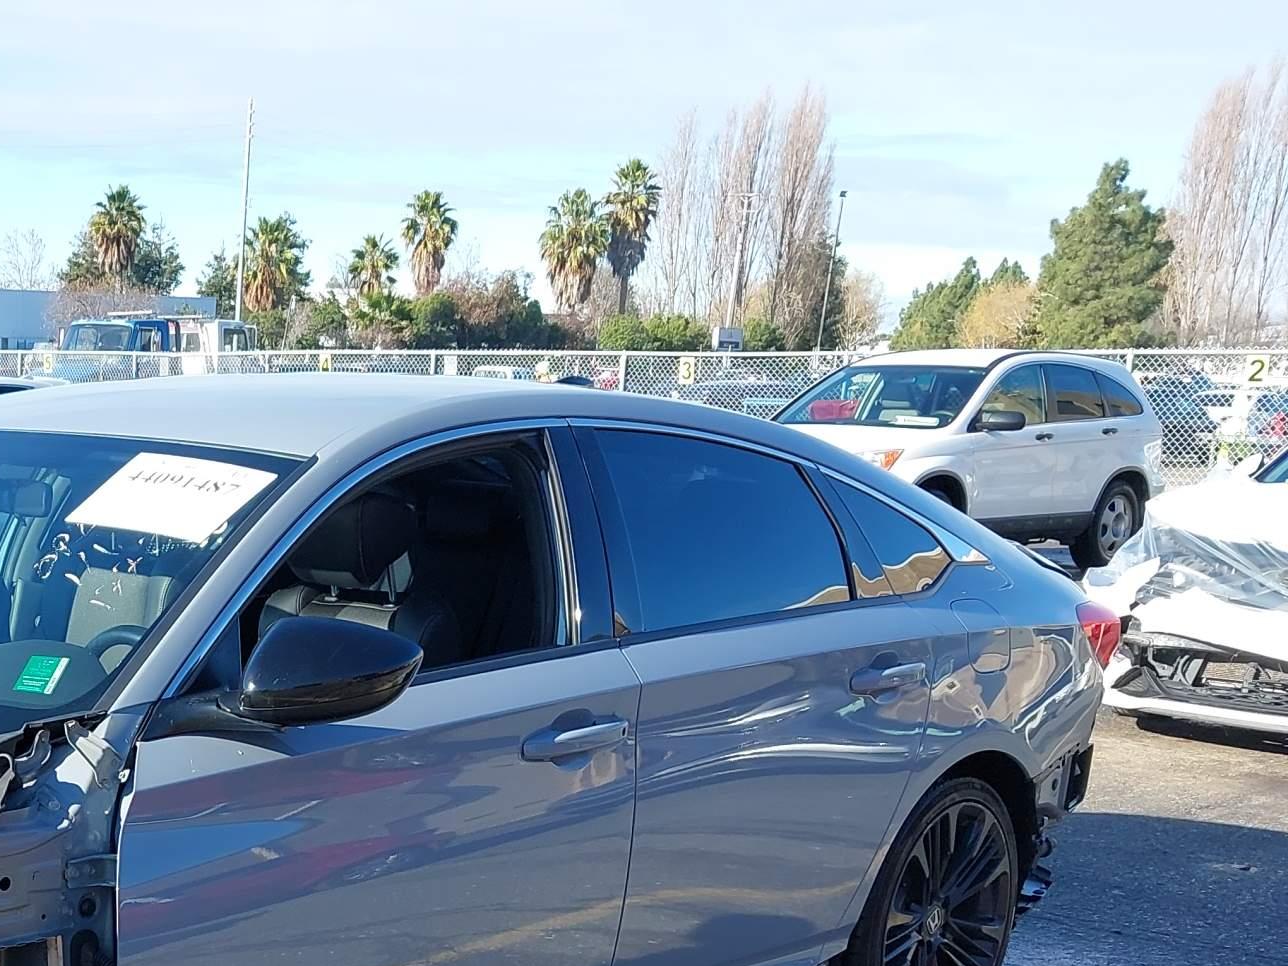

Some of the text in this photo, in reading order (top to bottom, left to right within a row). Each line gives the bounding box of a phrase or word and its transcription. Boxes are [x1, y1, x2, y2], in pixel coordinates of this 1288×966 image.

[682, 360, 691, 380] 3
[1247, 359, 1266, 382] 2
[128, 470, 241, 495] 44091487
